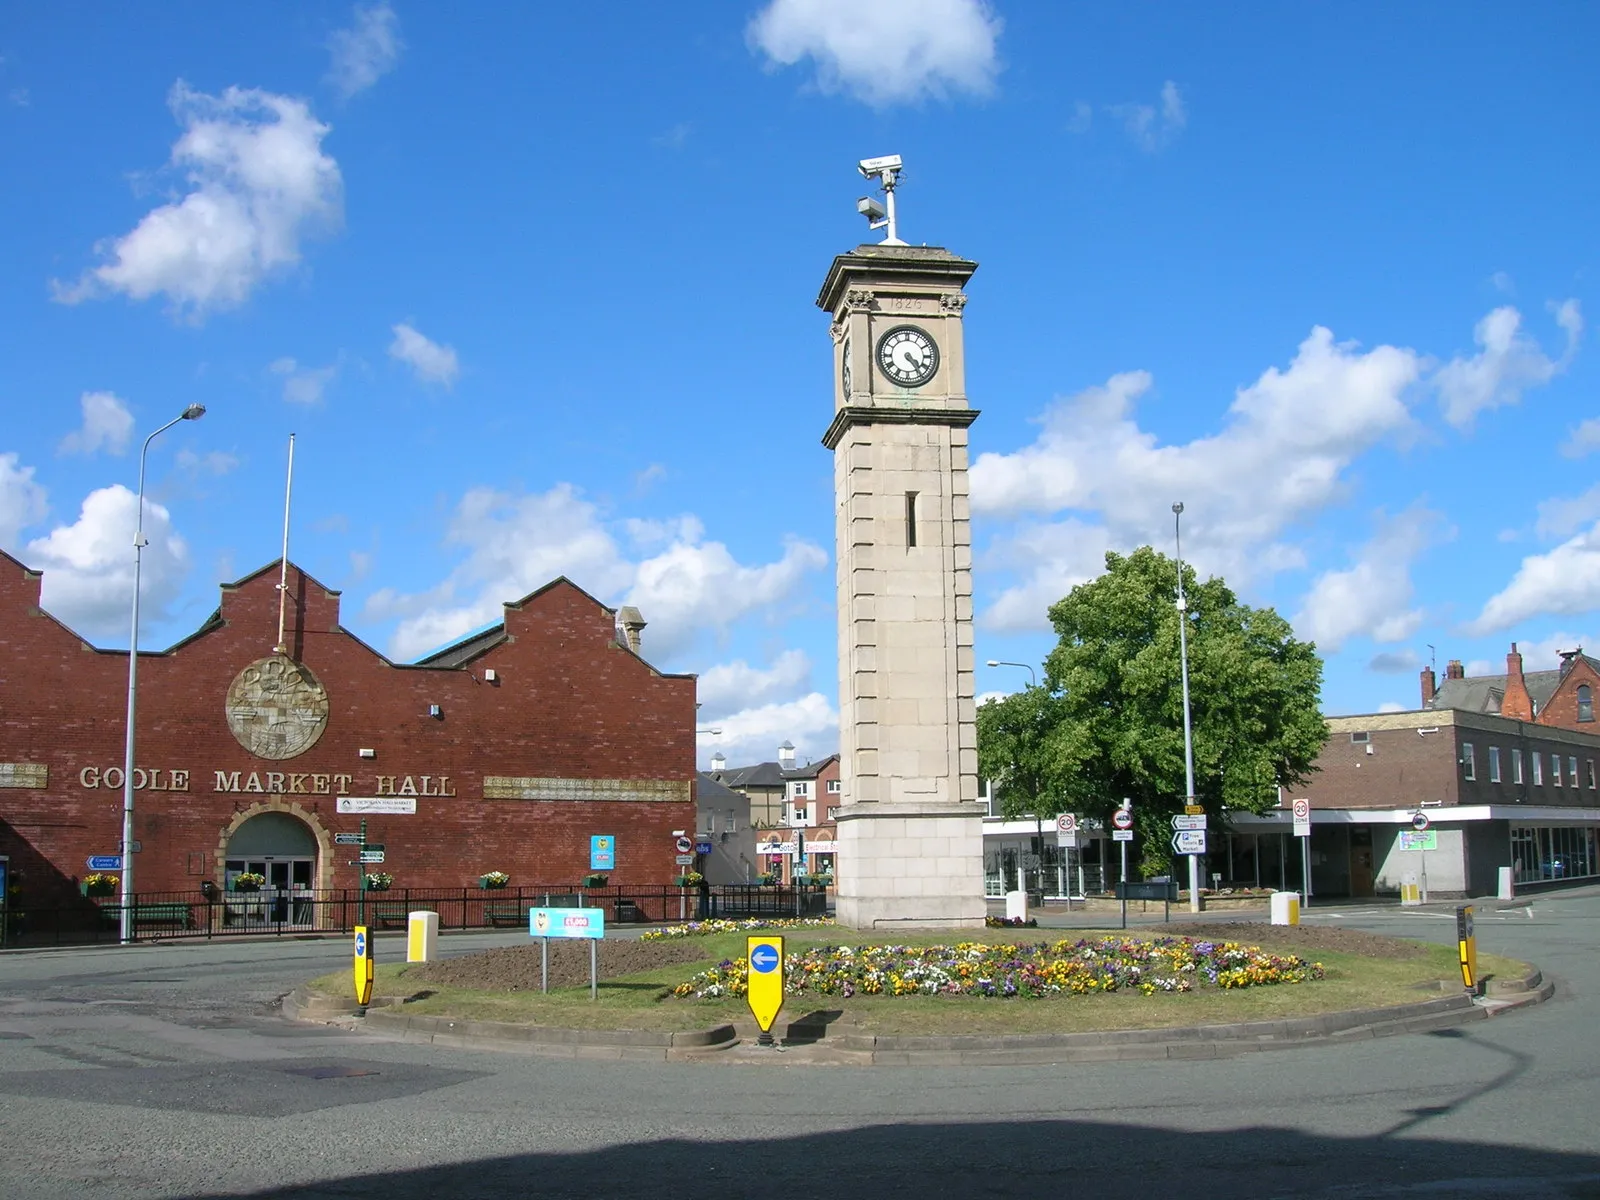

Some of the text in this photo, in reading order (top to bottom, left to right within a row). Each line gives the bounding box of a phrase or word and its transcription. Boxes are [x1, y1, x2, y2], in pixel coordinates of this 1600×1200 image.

[891, 298, 922, 310] 1826
[80, 767, 457, 797] GOOLE MARKET HALL
[1061, 818, 1072, 826] 20
